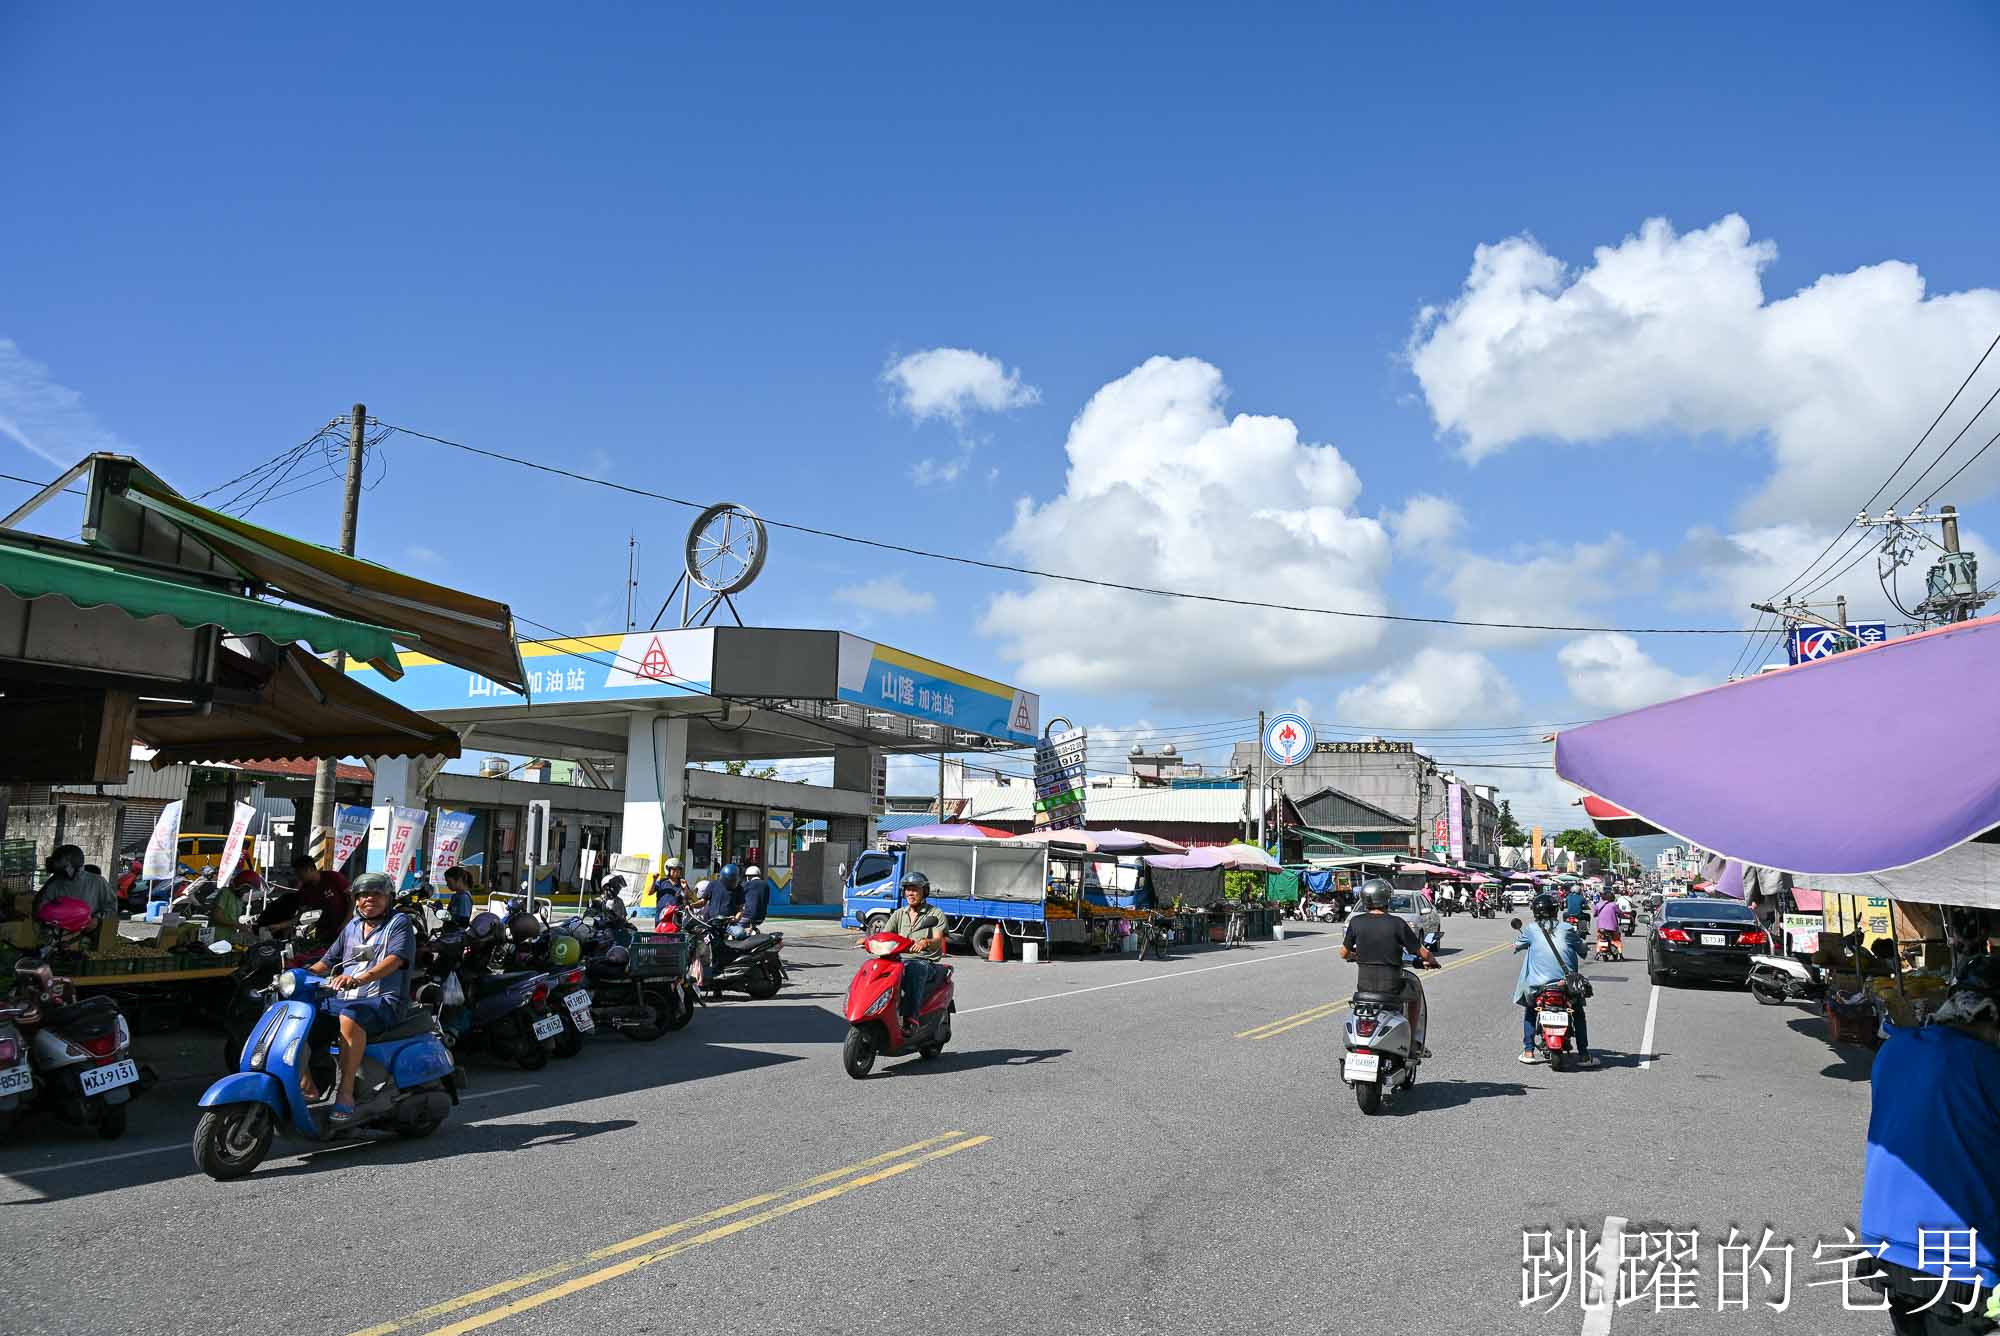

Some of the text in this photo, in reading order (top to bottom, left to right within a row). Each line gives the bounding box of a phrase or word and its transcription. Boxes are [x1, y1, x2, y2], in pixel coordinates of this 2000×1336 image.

[528, 668, 585, 693] 加油站
[881, 671, 955, 716] 山隆 加油站
[1062, 754, 1081, 767] 912
[83, 1065, 134, 1090] MXJ-9131
